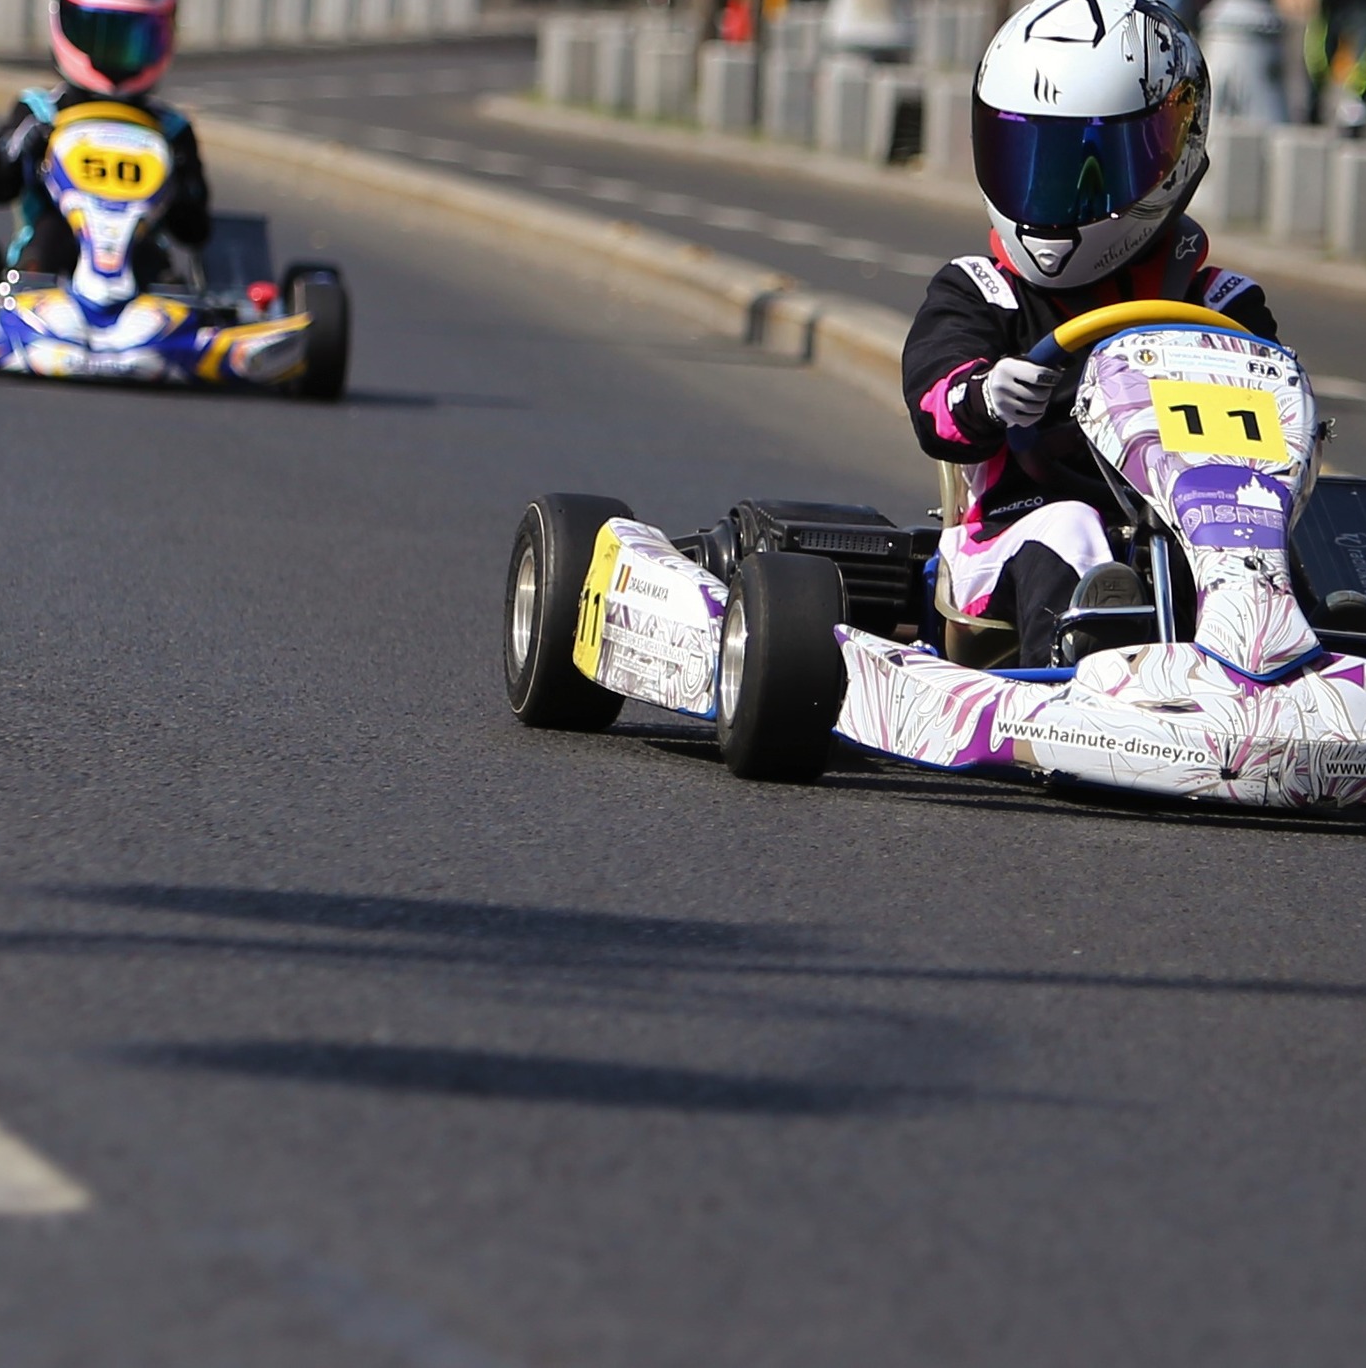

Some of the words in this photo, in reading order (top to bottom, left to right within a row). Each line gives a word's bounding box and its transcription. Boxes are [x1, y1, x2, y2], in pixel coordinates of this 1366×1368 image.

[83, 157, 141, 184] 50
[1169, 404, 1263, 442] 11
[580, 588, 601, 647] 11
[997, 719, 1206, 764] www.hainute-disney.ro
